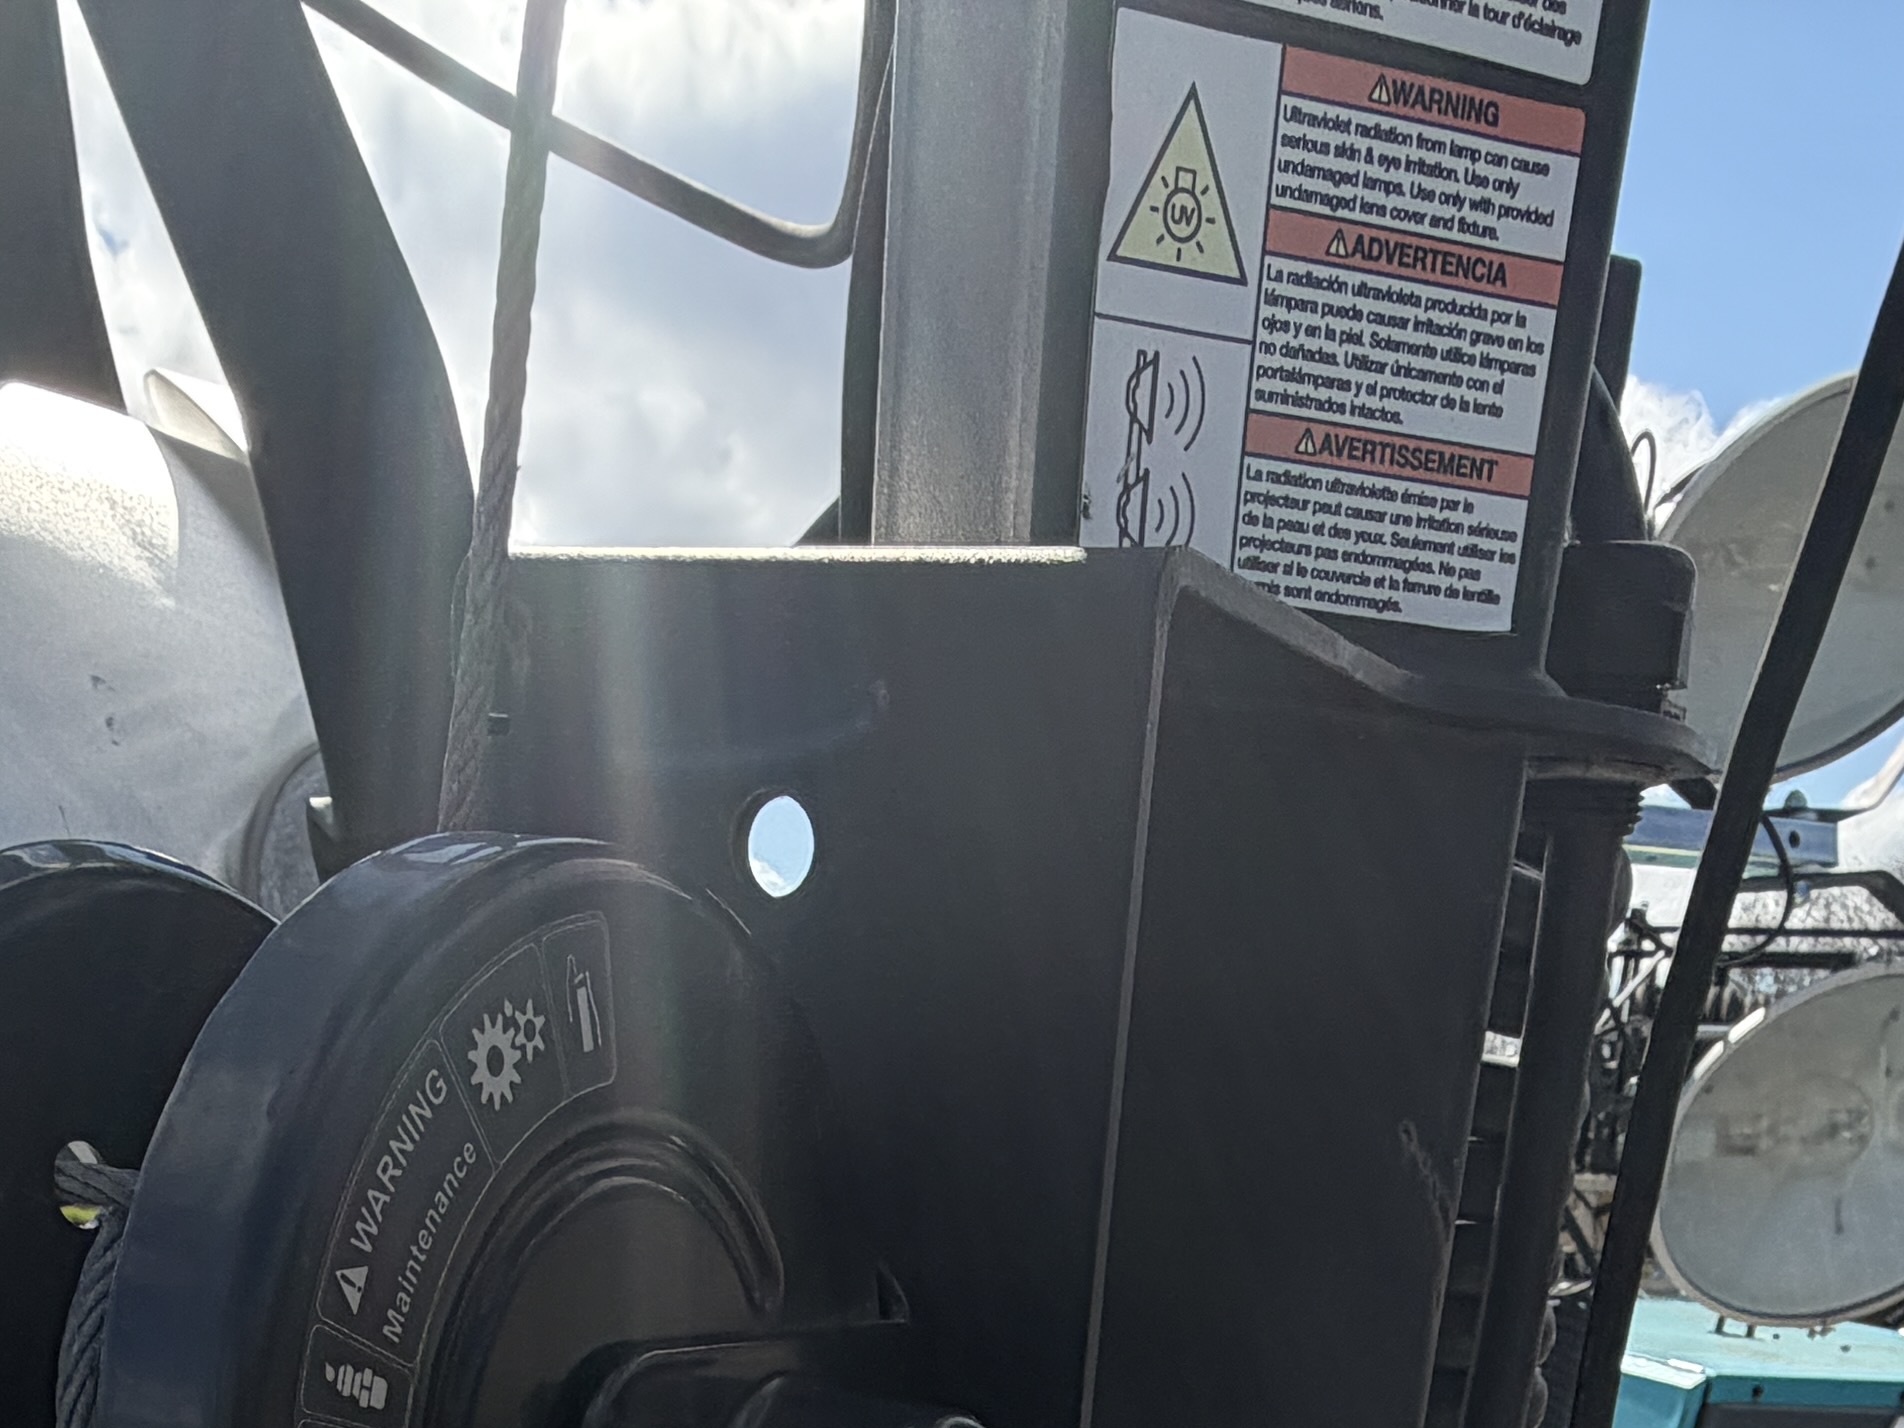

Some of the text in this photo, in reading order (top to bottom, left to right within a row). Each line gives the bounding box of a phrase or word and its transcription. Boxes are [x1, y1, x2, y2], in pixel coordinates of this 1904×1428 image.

[1393, 80, 1499, 127] WARNING
[1280, 133, 1521, 199] serious skin & eye irritation. Use only
[1283, 105, 1550, 177] Ultraviolet radiation from lamp can cause
[1170, 202, 1195, 227] UV
[1275, 184, 1455, 232] undamaged lens cover and
[1277, 158, 1555, 228] undamaged lamps. Use only with provided
[1352, 235, 1507, 287] ADVERTENCIA
[1266, 263, 1527, 329] La radiación ultravioleta producida por la
[1261, 313, 1537, 378] ojos y en la piel. Solamente utilice lámparas
[1263, 288, 1545, 356] lámpara puede causar irritación grave en los
[1258, 340, 1505, 396] no Utilizar únicamente con el
[1254, 388, 1347, 415] suministrados
[1353, 380, 1504, 419] y el protector de la lente
[1319, 433, 1498, 481] AVERTISSEMENT
[1243, 490, 1465, 535] projecteur peut causer une irritation
[1245, 463, 1461, 512] La radiation ultraviolette émise par
[1241, 510, 1455, 555] de la peau et des Seulement
[1239, 535, 1482, 582] projecteurs pas Ne pas
[349, 1066, 449, 1255] WARNING
[381, 1140, 480, 1345] Maintenance
